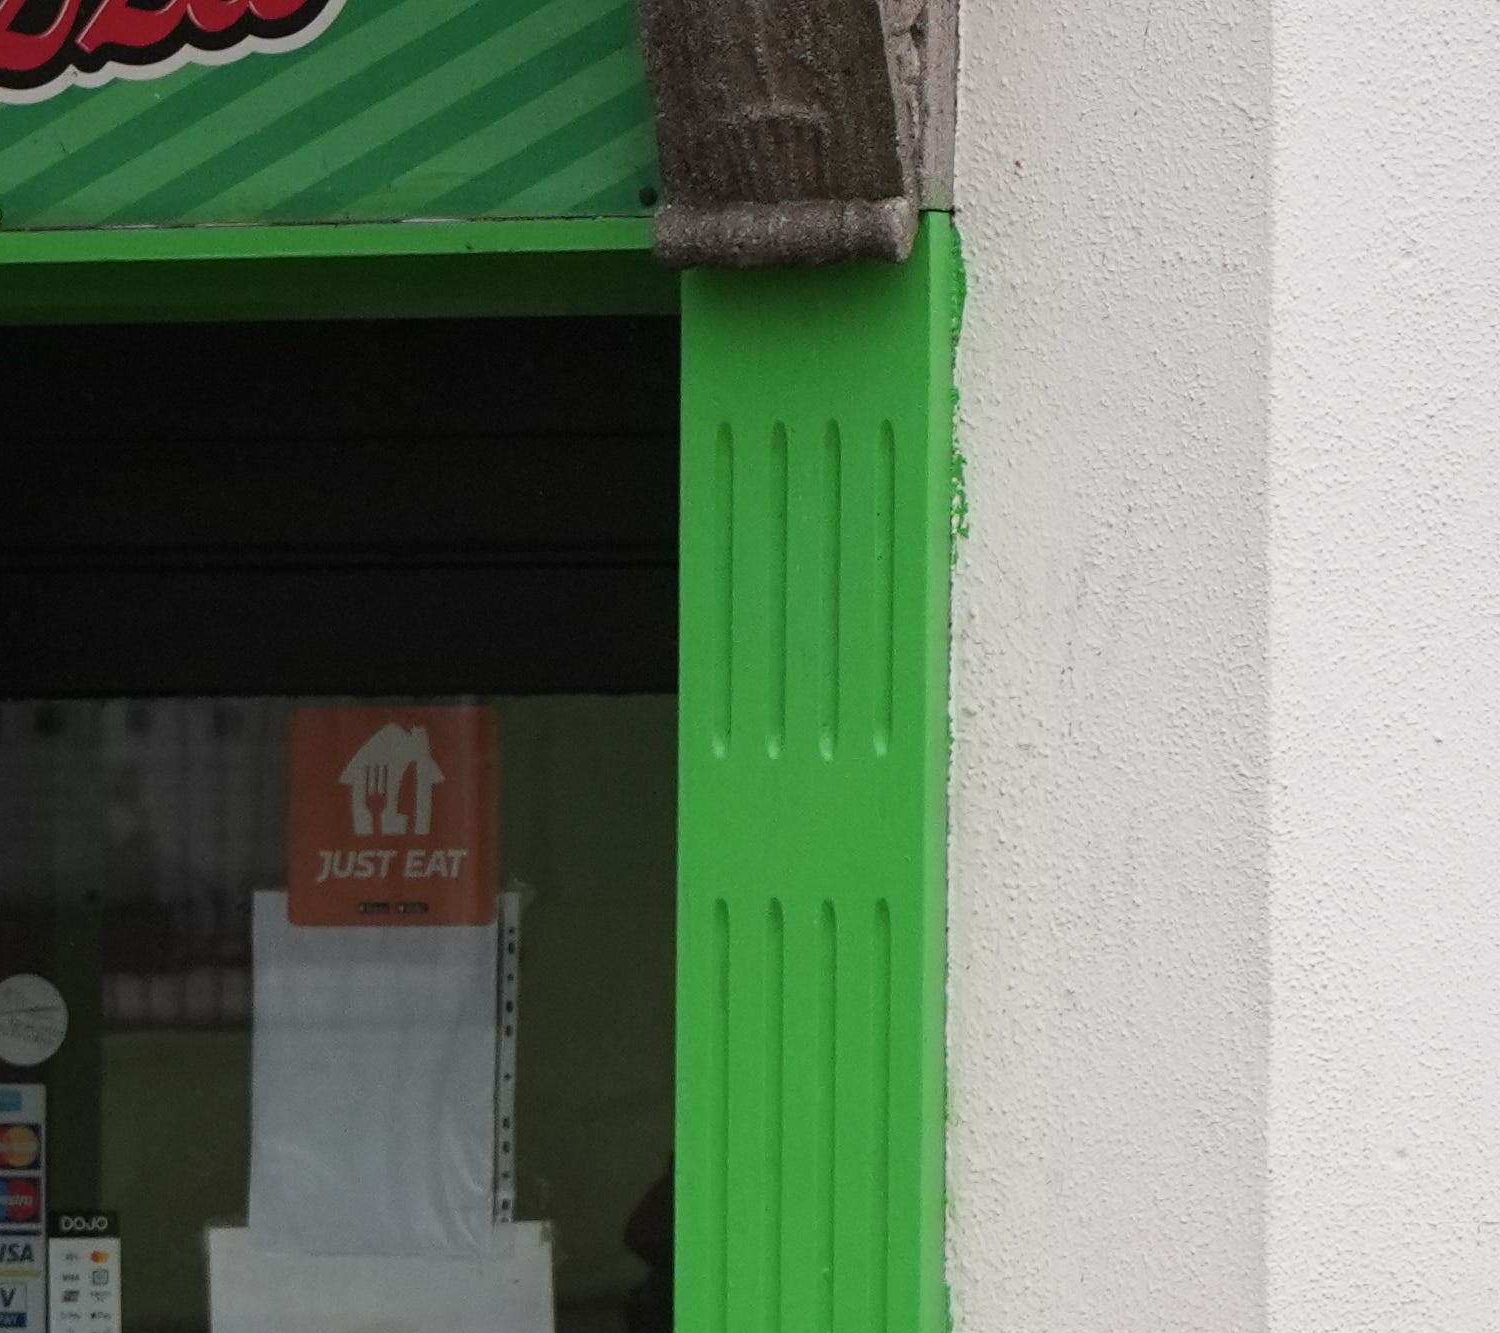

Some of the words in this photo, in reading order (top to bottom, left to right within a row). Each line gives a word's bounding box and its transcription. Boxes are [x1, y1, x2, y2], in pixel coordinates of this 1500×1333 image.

[316, 848, 398, 884] JUST
[403, 848, 469, 880] EAT
[59, 1215, 109, 1232] DOJO
